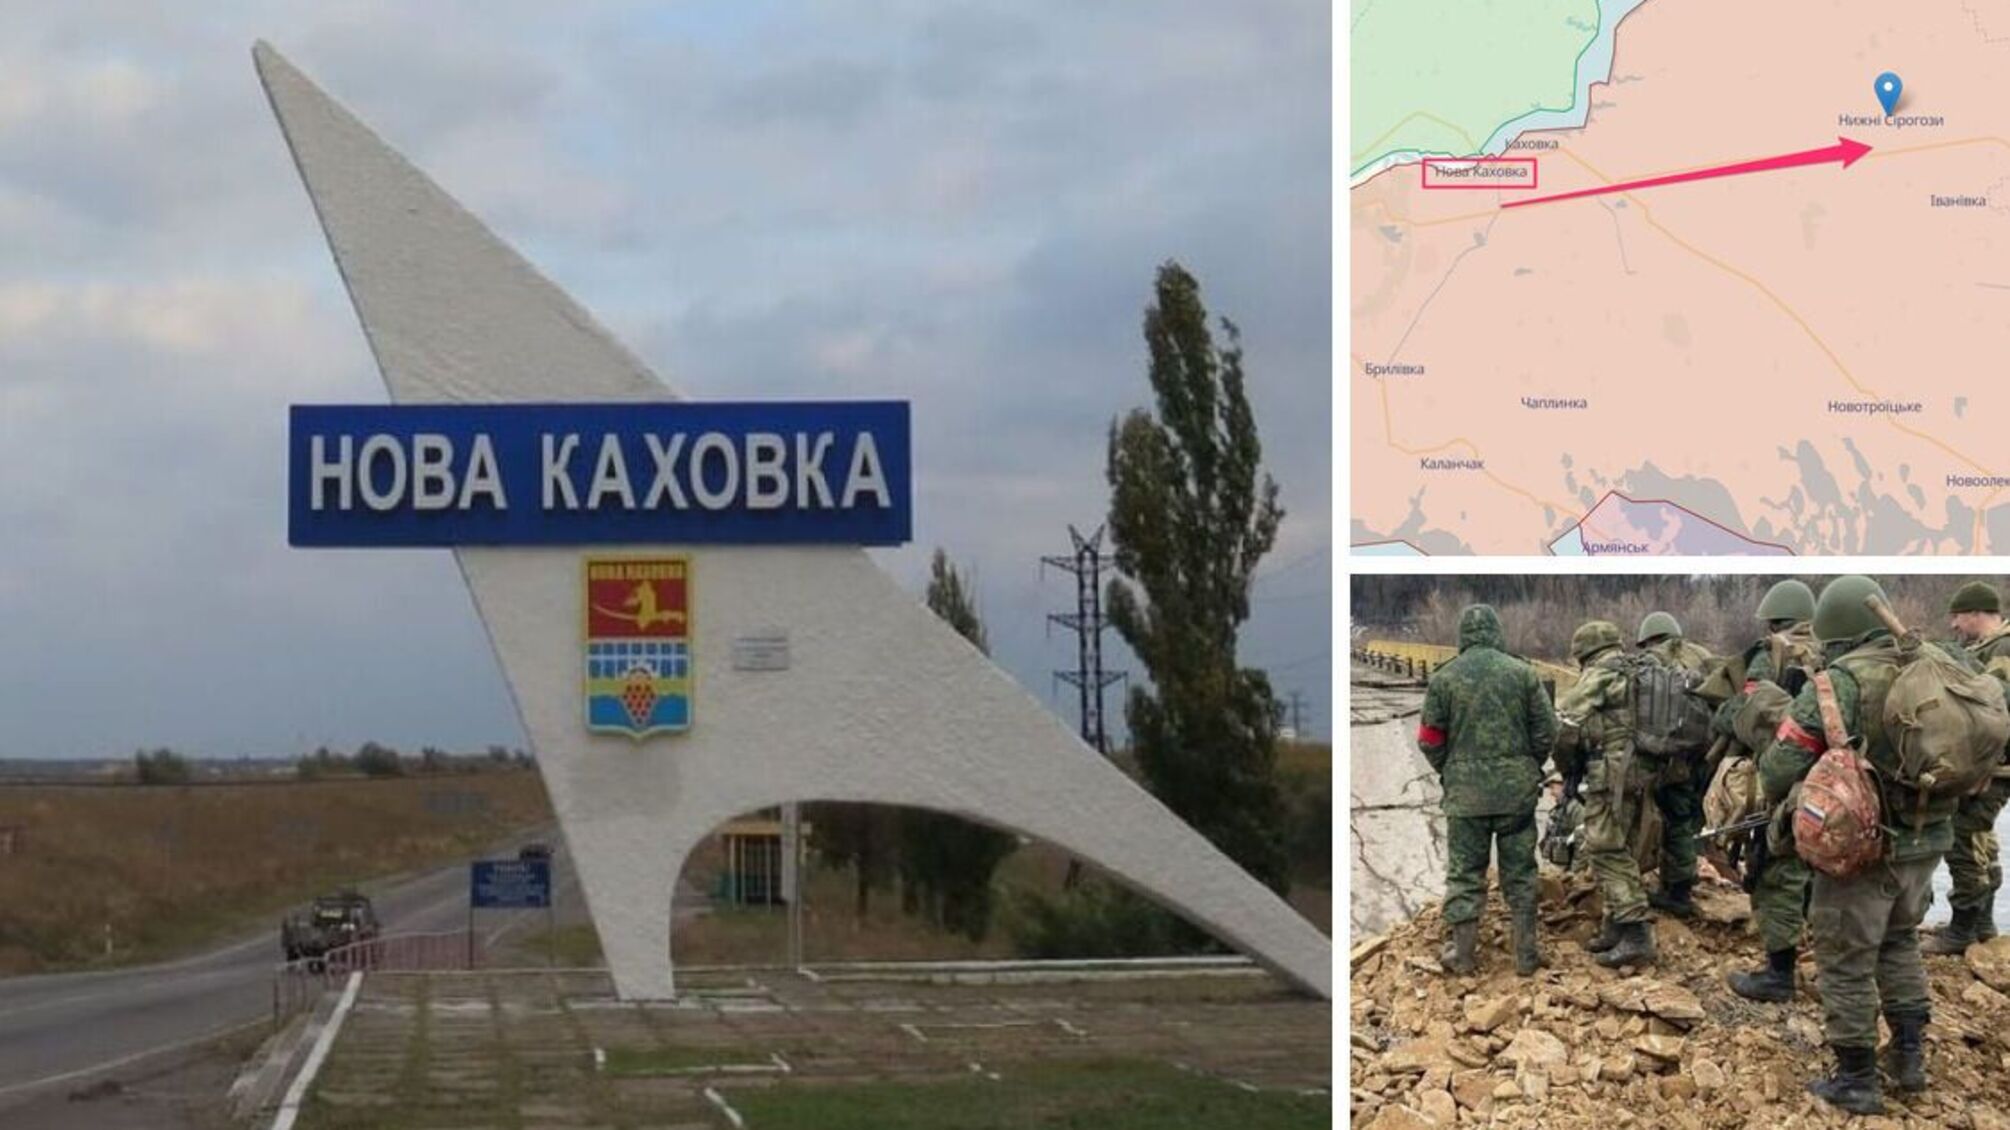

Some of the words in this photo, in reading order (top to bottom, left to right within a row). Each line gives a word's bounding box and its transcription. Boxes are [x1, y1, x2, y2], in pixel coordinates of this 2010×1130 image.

[1838, 114, 1881, 127] Нижні
[1885, 113, 1944, 129] Сірогози
[1505, 138, 1559, 150] Каховка
[1435, 166, 1470, 178] Нова
[1473, 166, 1528, 178] Каховка
[1930, 194, 1986, 207] Іванівка
[1521, 397, 1588, 409] Чаплинка
[1828, 400, 1923, 415] Новотроїцьке
[1420, 457, 1485, 470] Каланчак
[310, 433, 507, 511] НОВА
[541, 431, 891, 509] КАХОВКА
